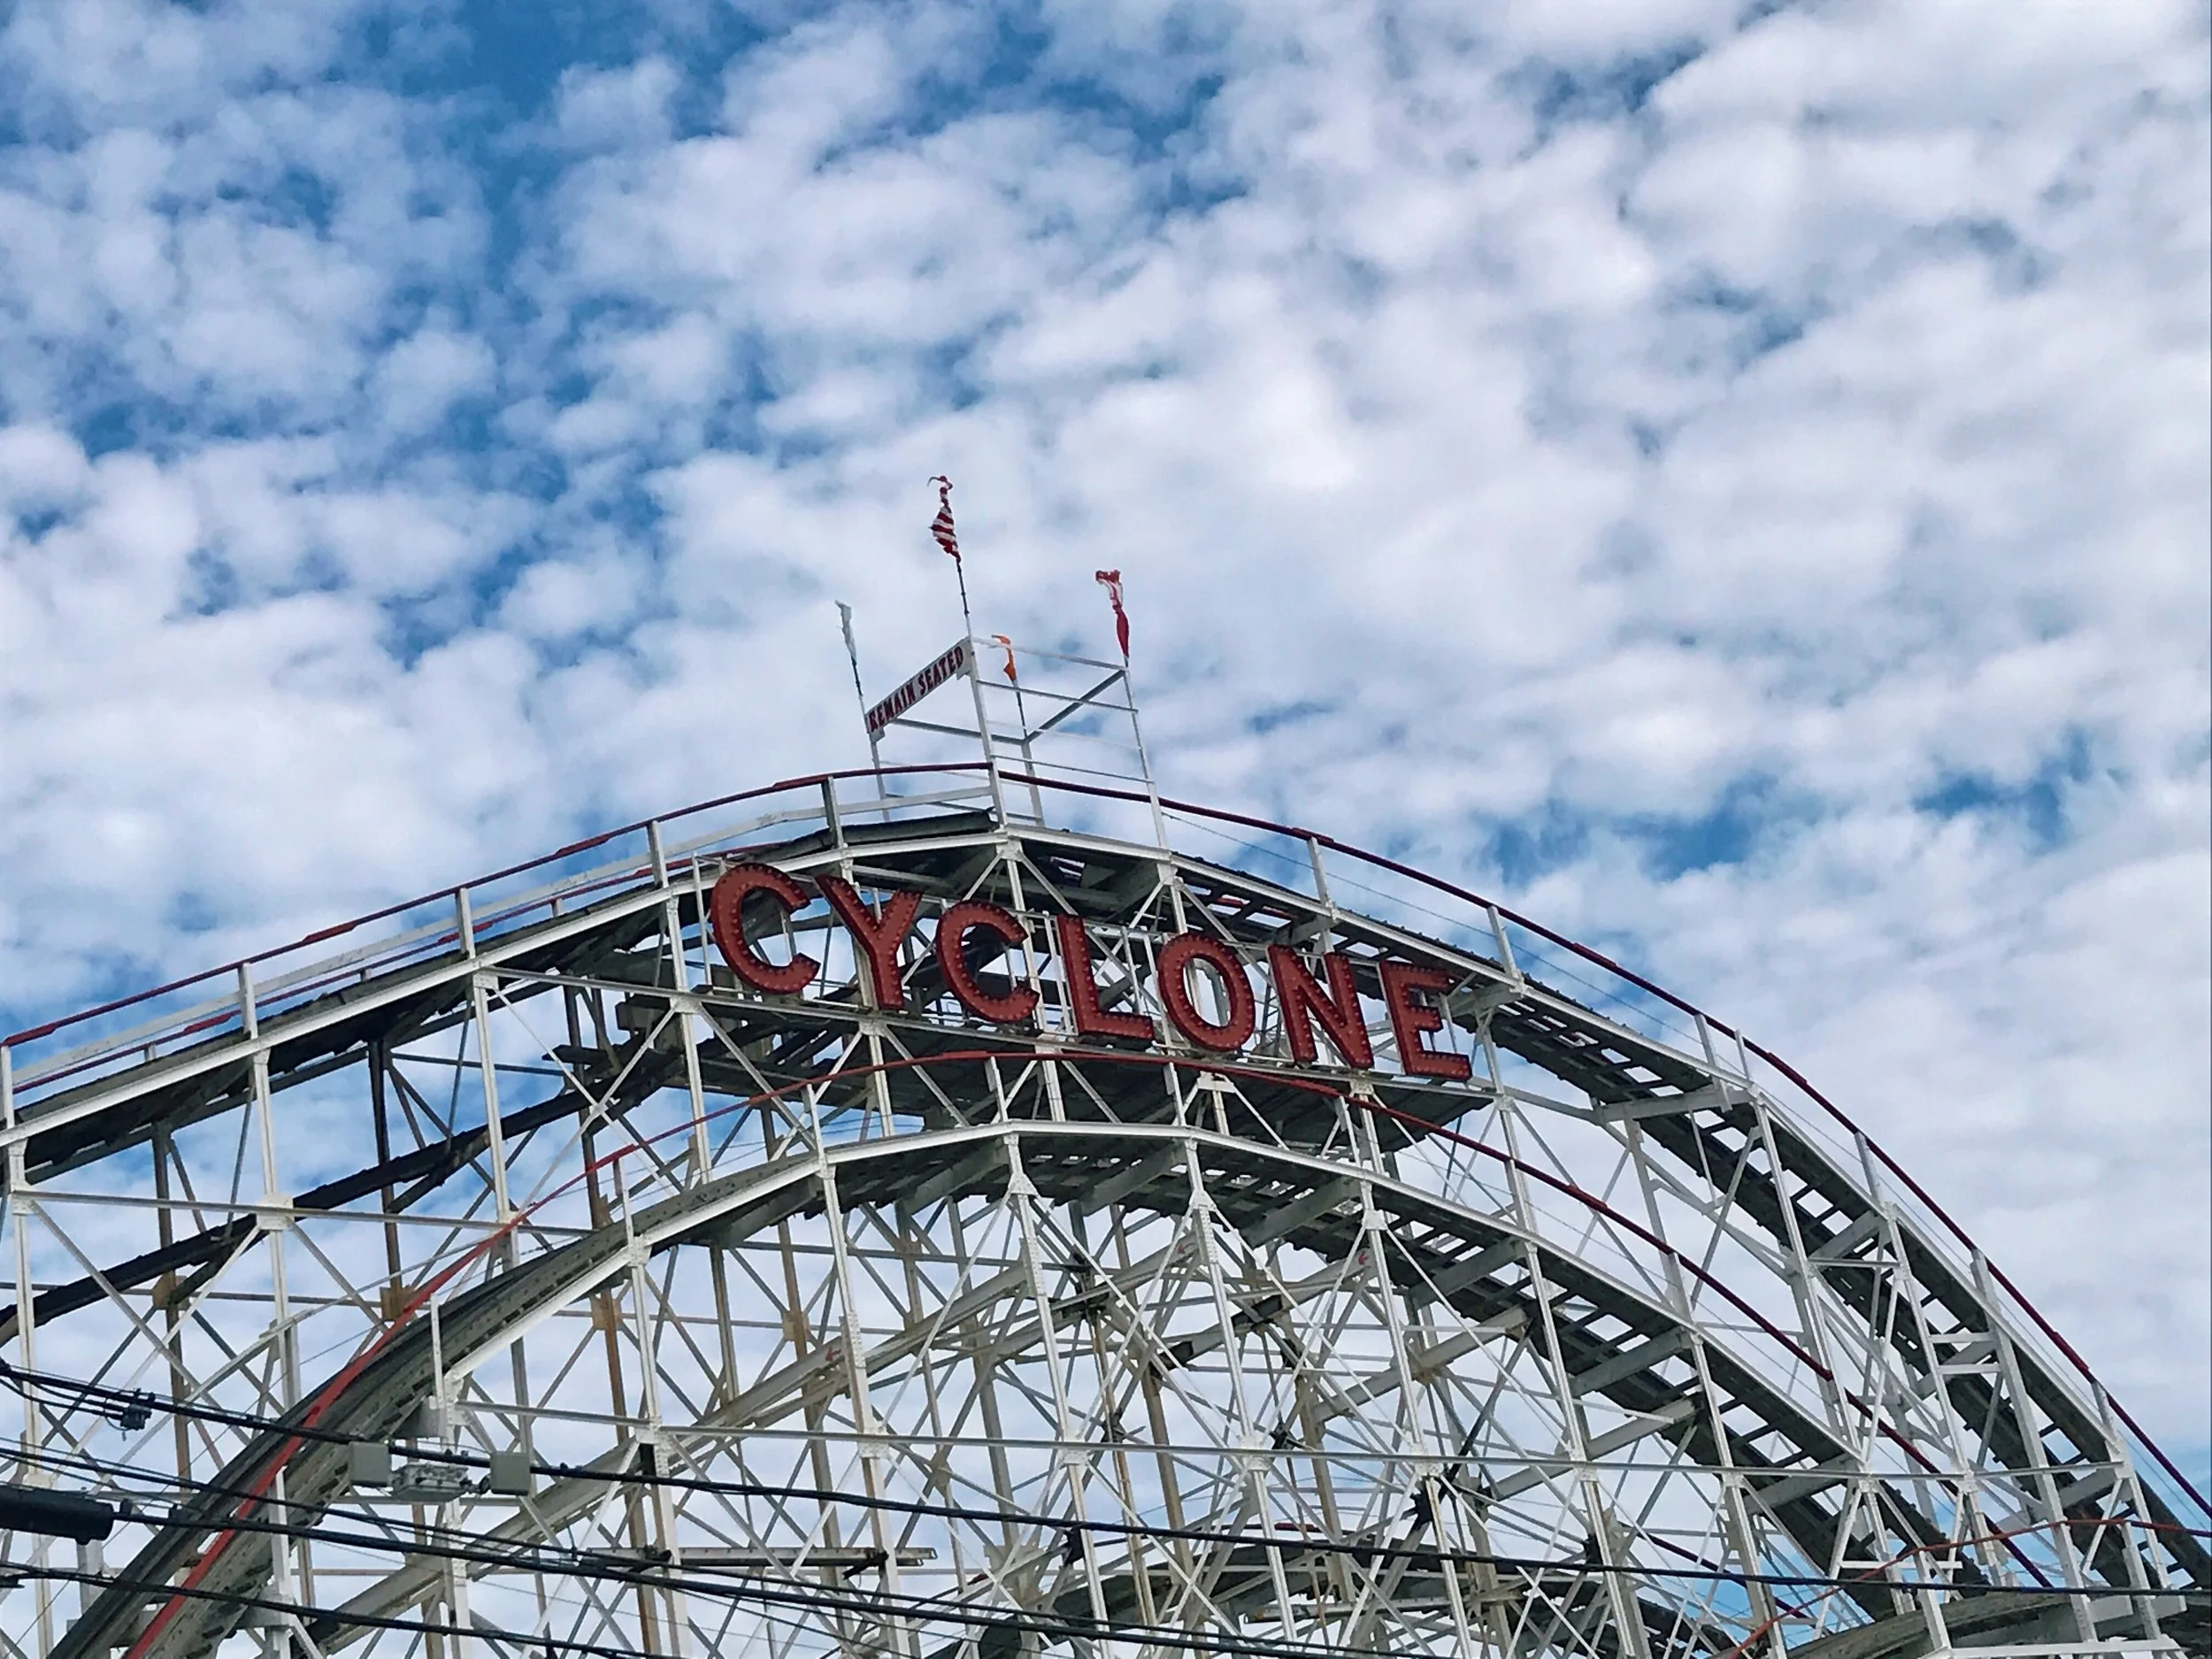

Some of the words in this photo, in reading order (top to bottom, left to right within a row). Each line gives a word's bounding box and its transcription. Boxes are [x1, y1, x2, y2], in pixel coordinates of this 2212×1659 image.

[867, 682, 916, 733] REMAIN
[918, 646, 964, 695] SEATED
[710, 862, 1471, 1082] CYCLONE
